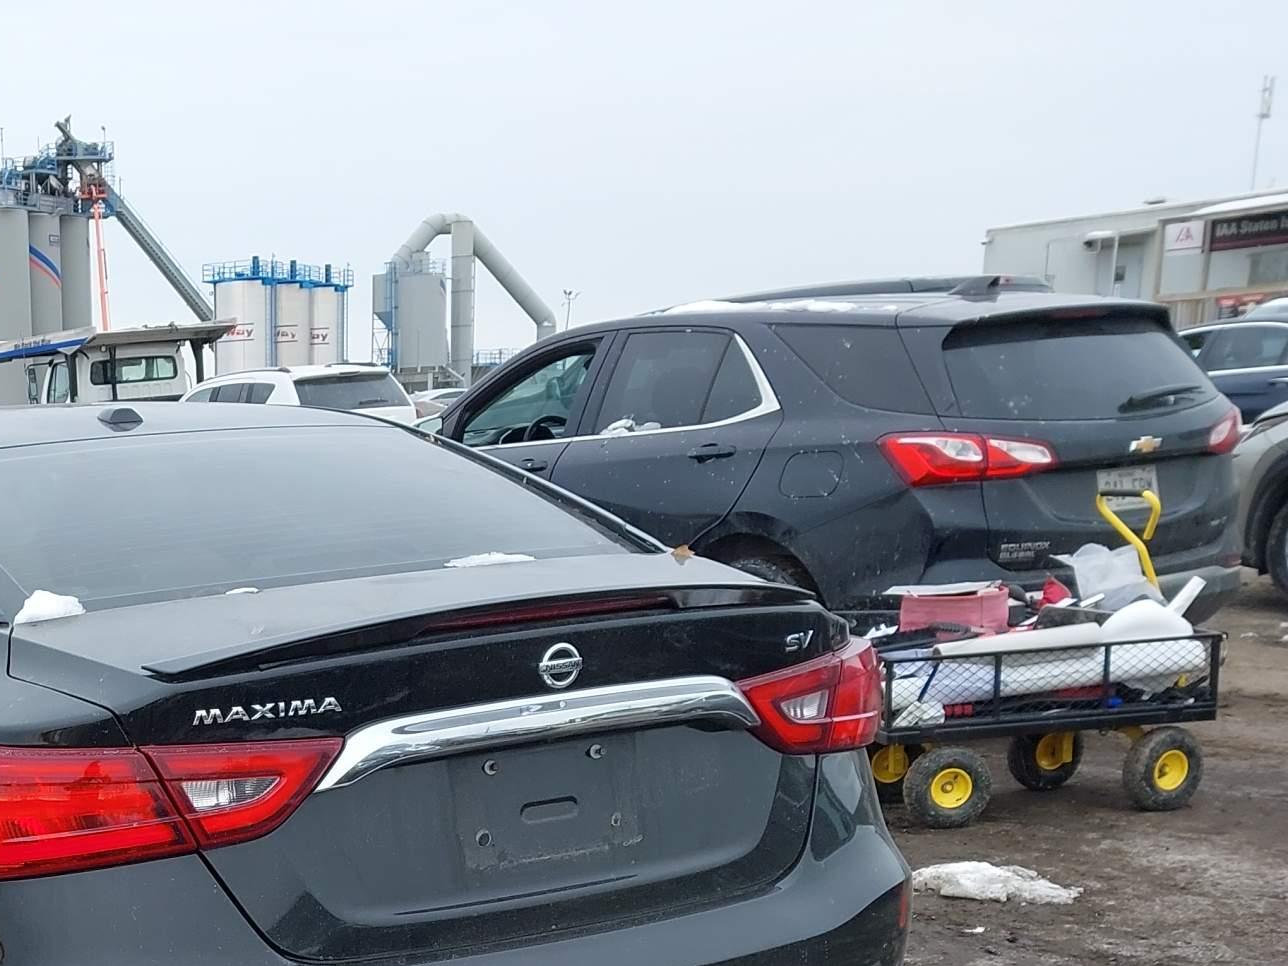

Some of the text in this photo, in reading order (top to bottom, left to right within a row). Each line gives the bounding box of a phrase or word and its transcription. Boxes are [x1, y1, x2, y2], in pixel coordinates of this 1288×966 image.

[785, 630, 814, 658] SV
[542, 659, 581, 673] NISSAN
[192, 696, 343, 726] MAXIMA
